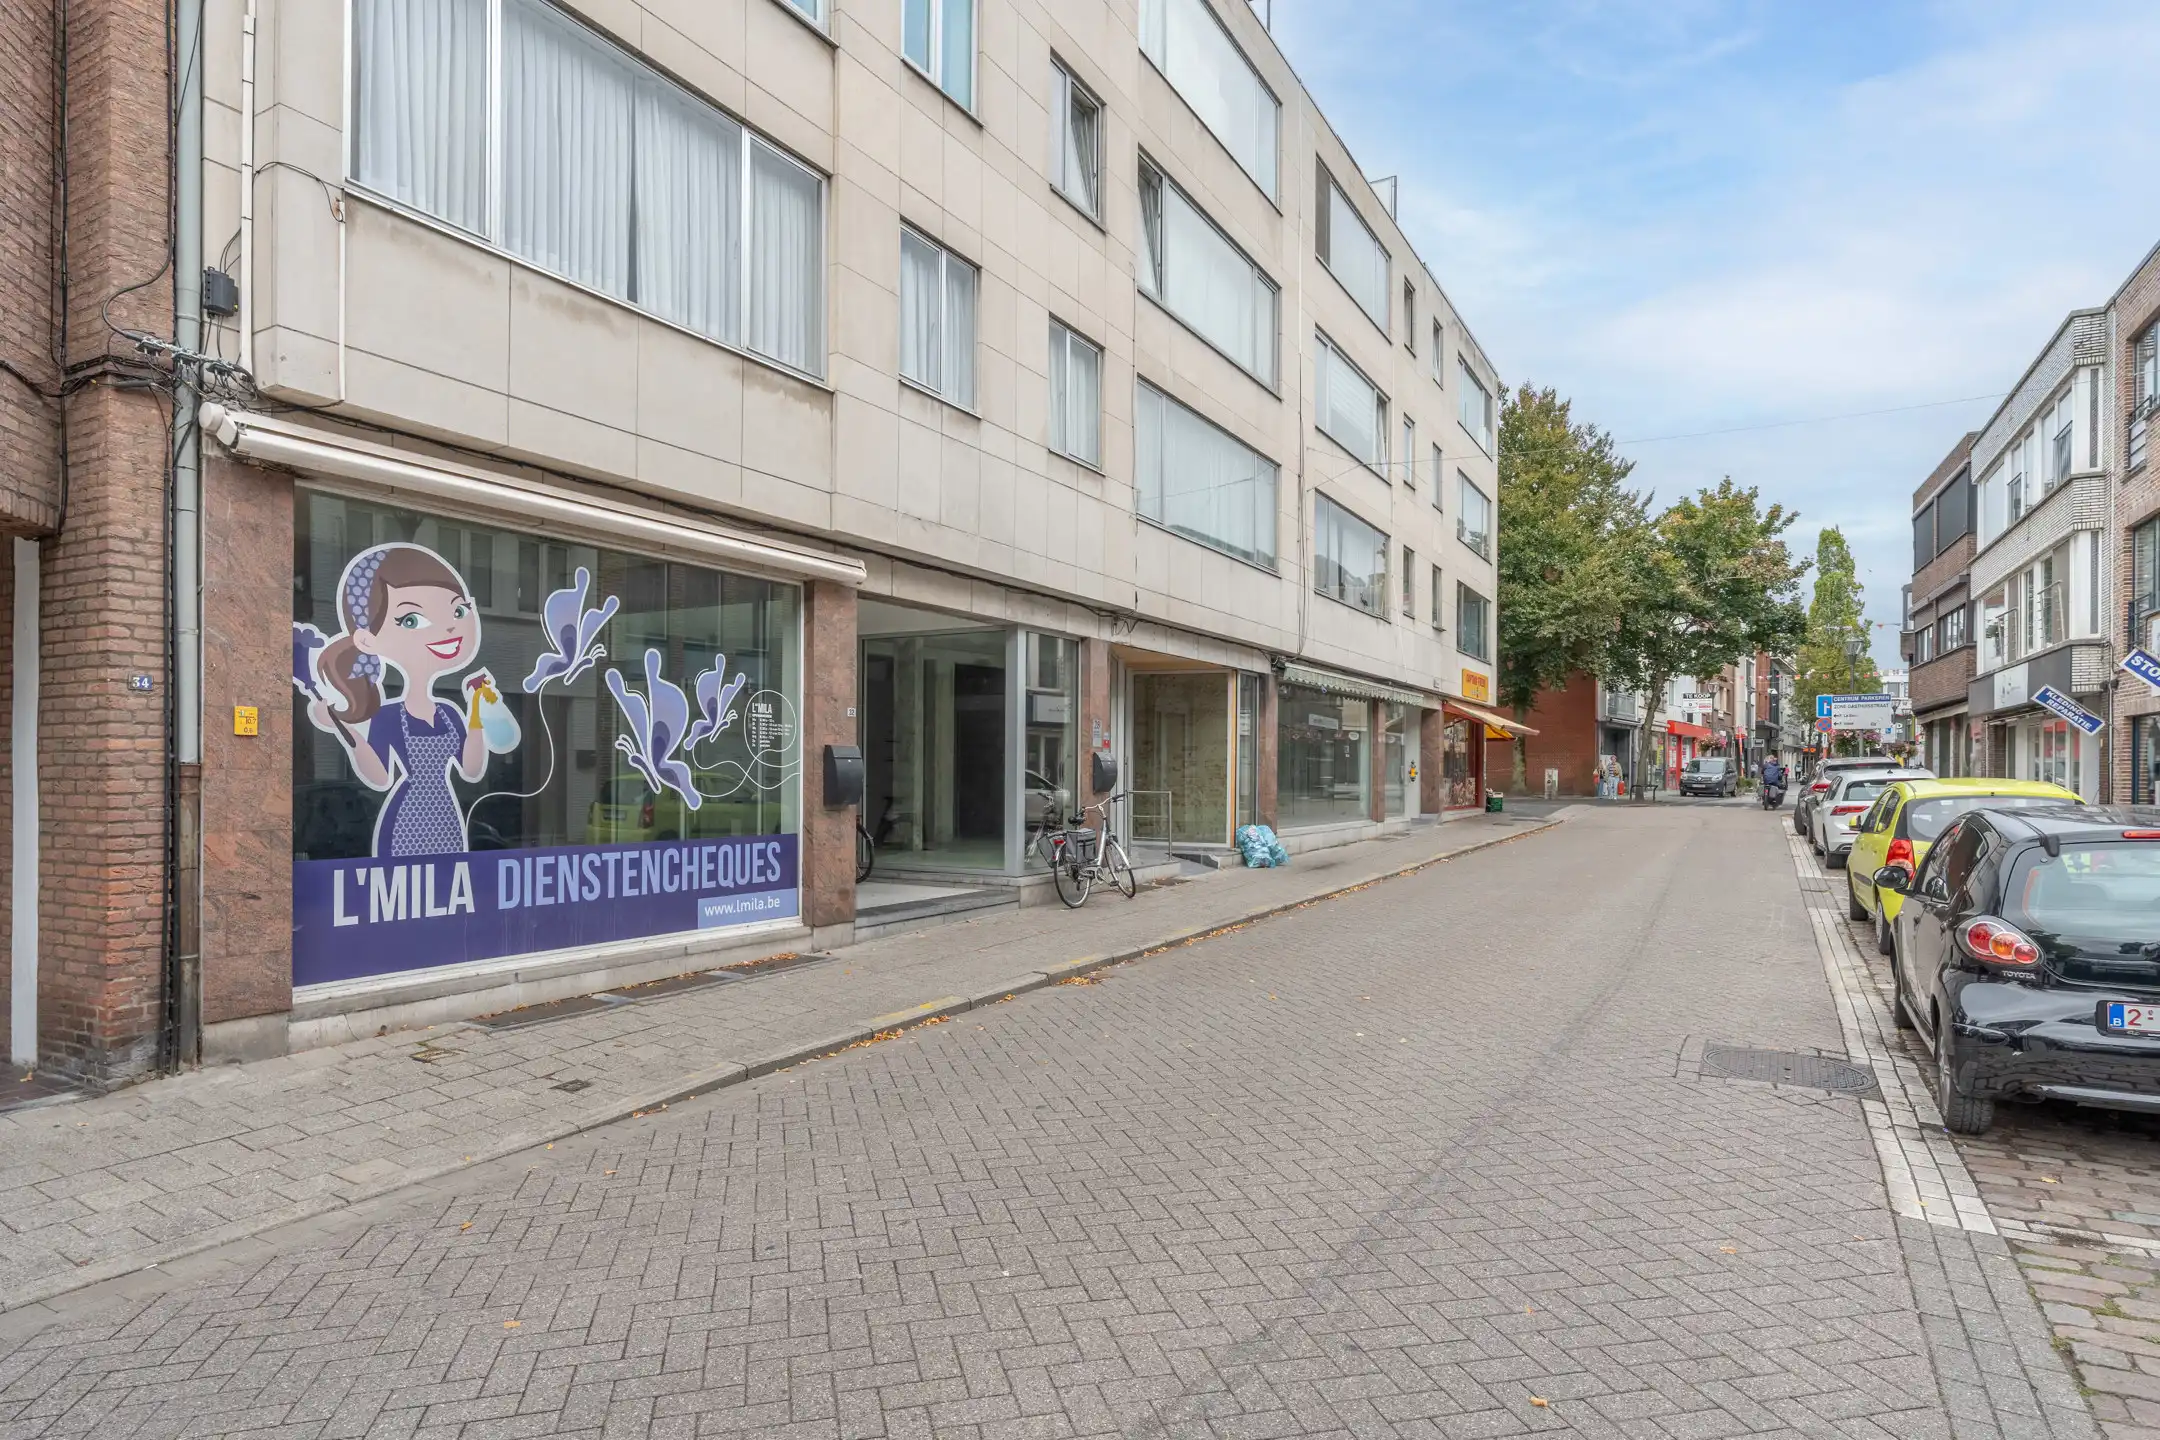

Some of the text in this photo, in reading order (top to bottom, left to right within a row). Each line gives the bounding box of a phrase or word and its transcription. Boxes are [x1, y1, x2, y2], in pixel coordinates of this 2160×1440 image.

[2131, 655, 2160, 681] STO
[132, 677, 149, 688] 34
[2046, 699, 2092, 730] REPARATIE
[334, 842, 781, 927] L'MILA DIENSTENCHEQUES
[704, 896, 781, 917] www.lmila.be
[2002, 970, 2037, 980] TOYOTA
[2113, 1018, 2122, 1026] B
